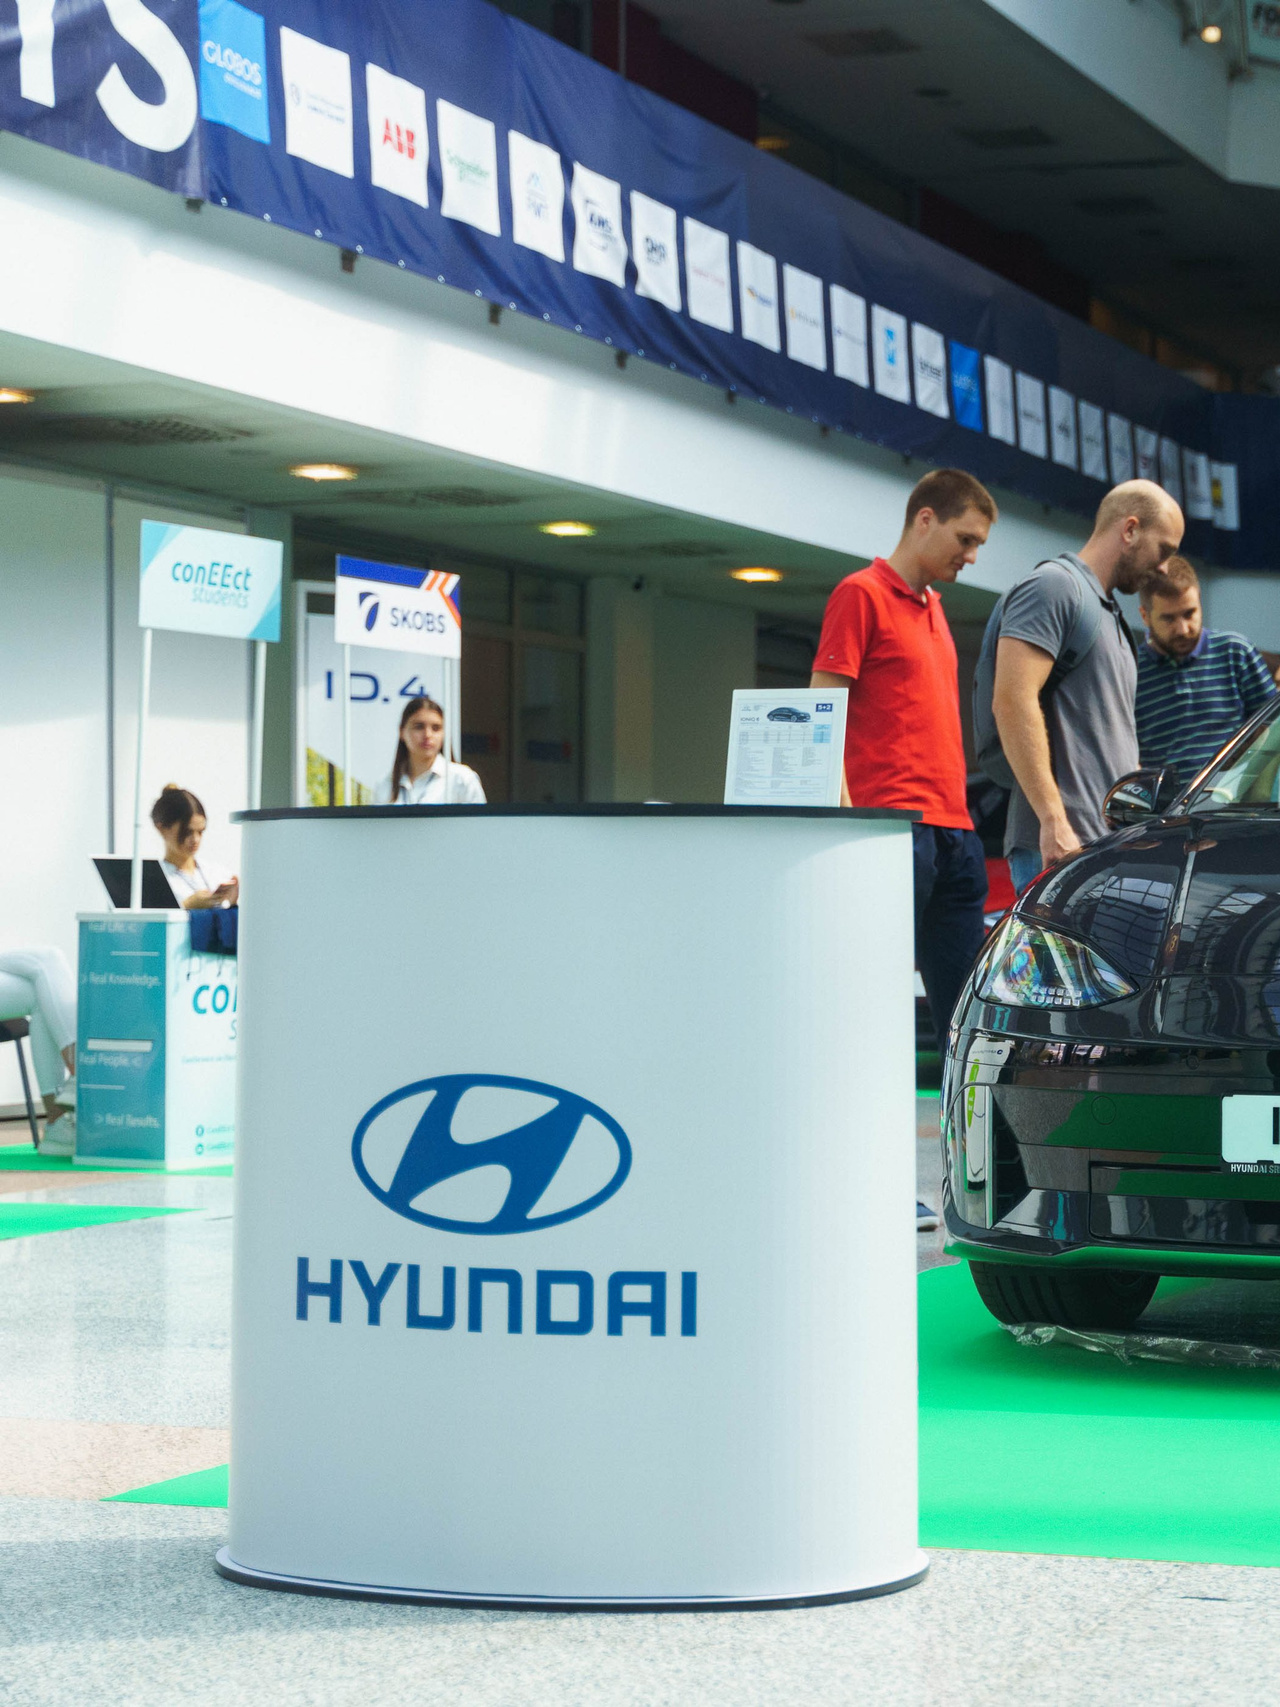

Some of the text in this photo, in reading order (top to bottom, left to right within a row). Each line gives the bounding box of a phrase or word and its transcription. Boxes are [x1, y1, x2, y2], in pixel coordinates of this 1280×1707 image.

[202, 40, 262, 85] GLOBOS
[383, 117, 416, 160] ABB
[172, 562, 251, 591] conEEct
[192, 586, 249, 609] students
[390, 606, 445, 634] SKOBS
[325, 669, 428, 703] ID.4
[817, 703, 832, 711] 5+2
[193, 984, 237, 1015] co
[1231, 1163, 1267, 1174] HYUNDAI
[296, 1256, 698, 1337] HYUNDAI
